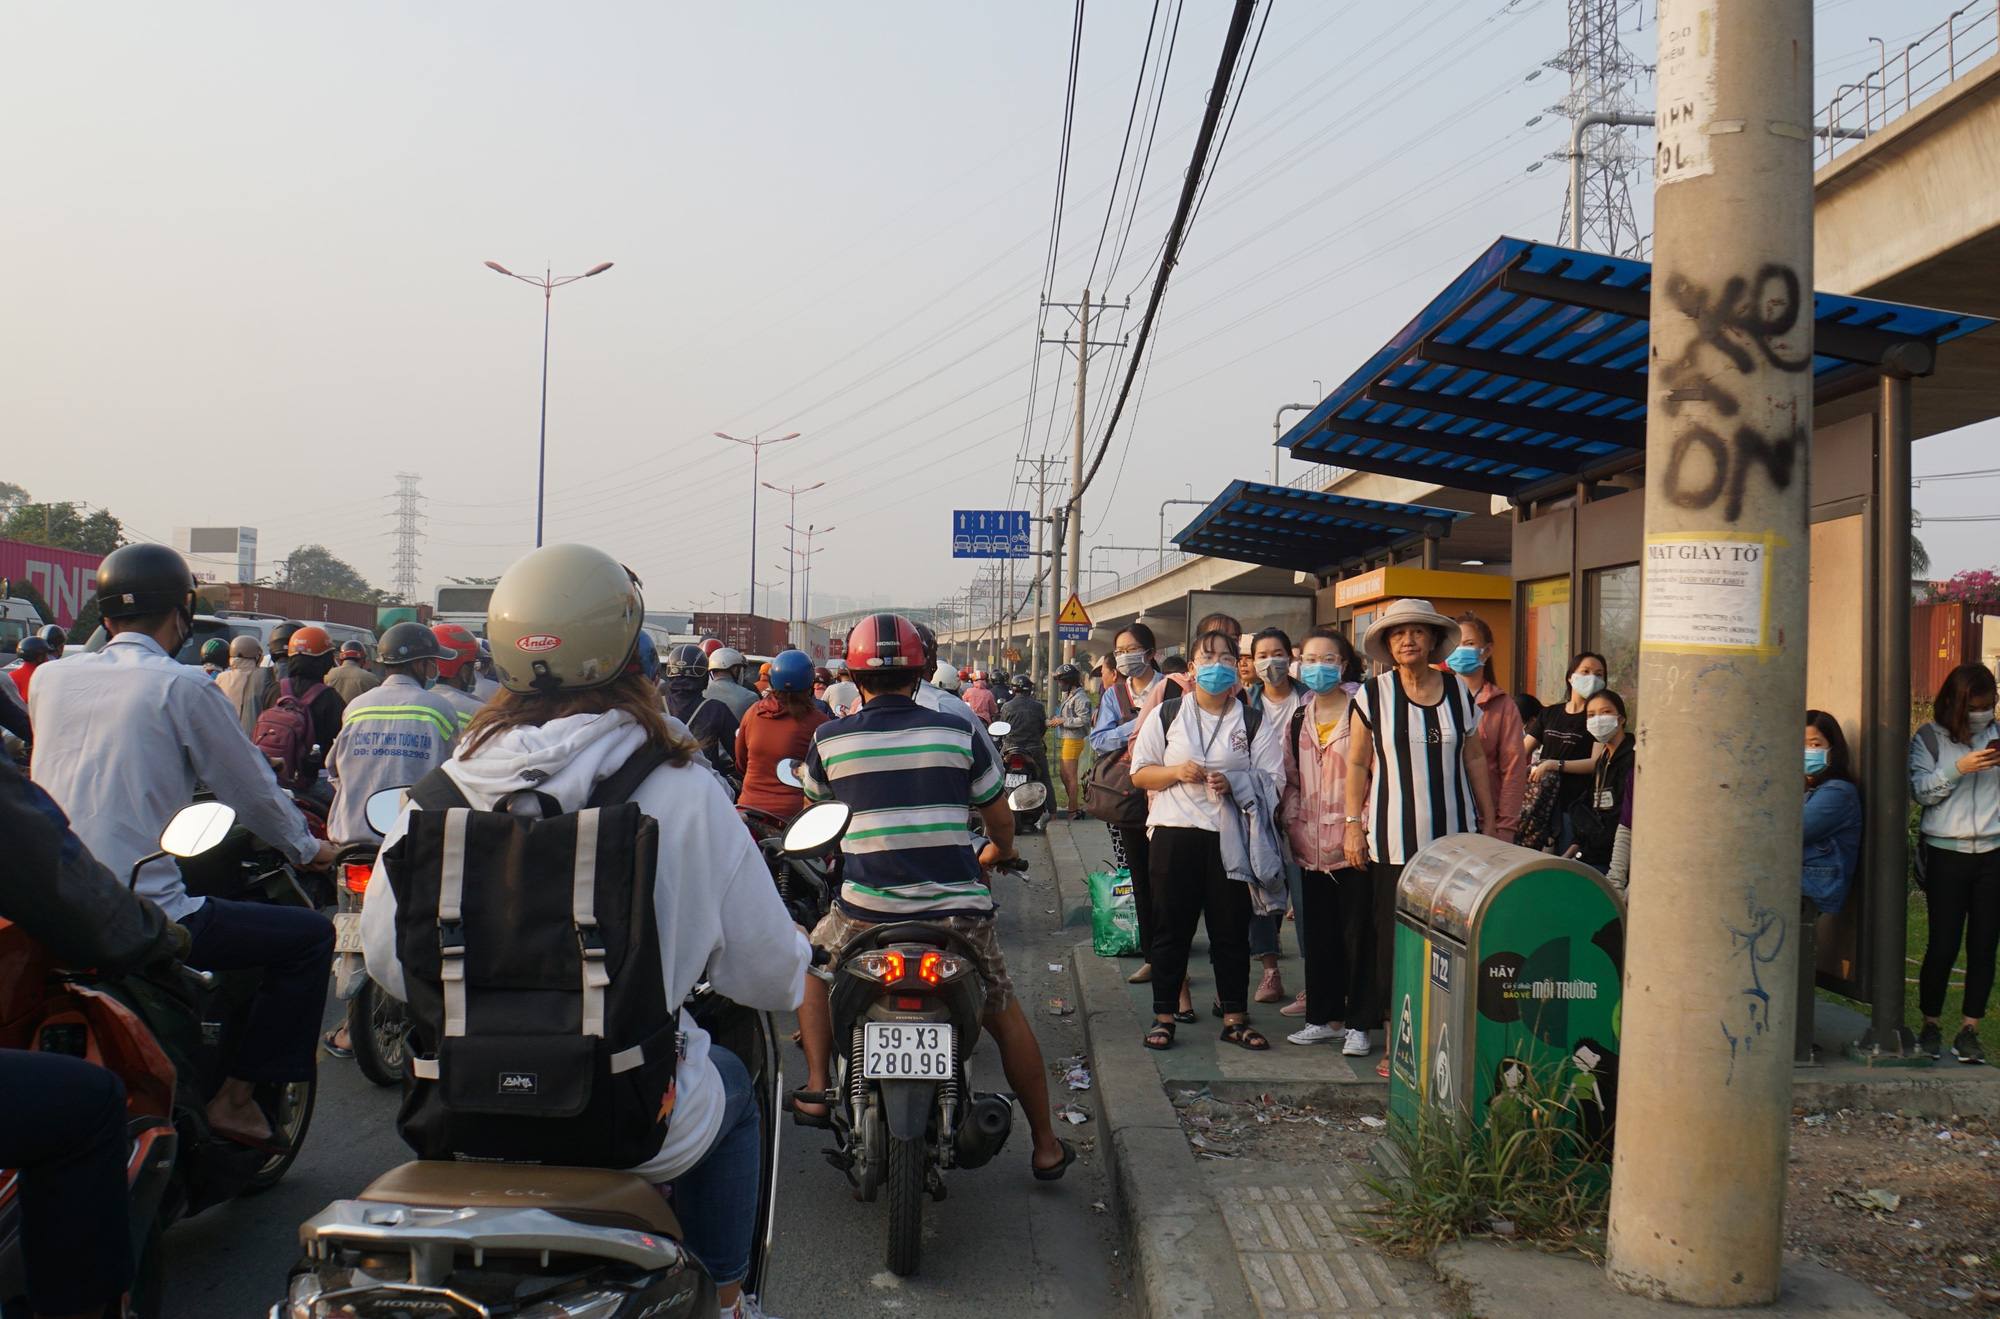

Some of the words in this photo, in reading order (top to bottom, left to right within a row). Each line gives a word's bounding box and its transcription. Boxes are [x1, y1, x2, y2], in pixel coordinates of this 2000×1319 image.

[1970, 611, 1984, 624] te
[521, 637, 559, 647] Andes
[1489, 965, 1515, 977] HÃY
[1532, 979, 1554, 999] MÔI
[1556, 978, 1597, 999] TRƯỜNG
[879, 1027, 939, 1050] 59-X3
[870, 1052, 947, 1075] 280.96
[372, 1300, 453, 1312] HONDA
